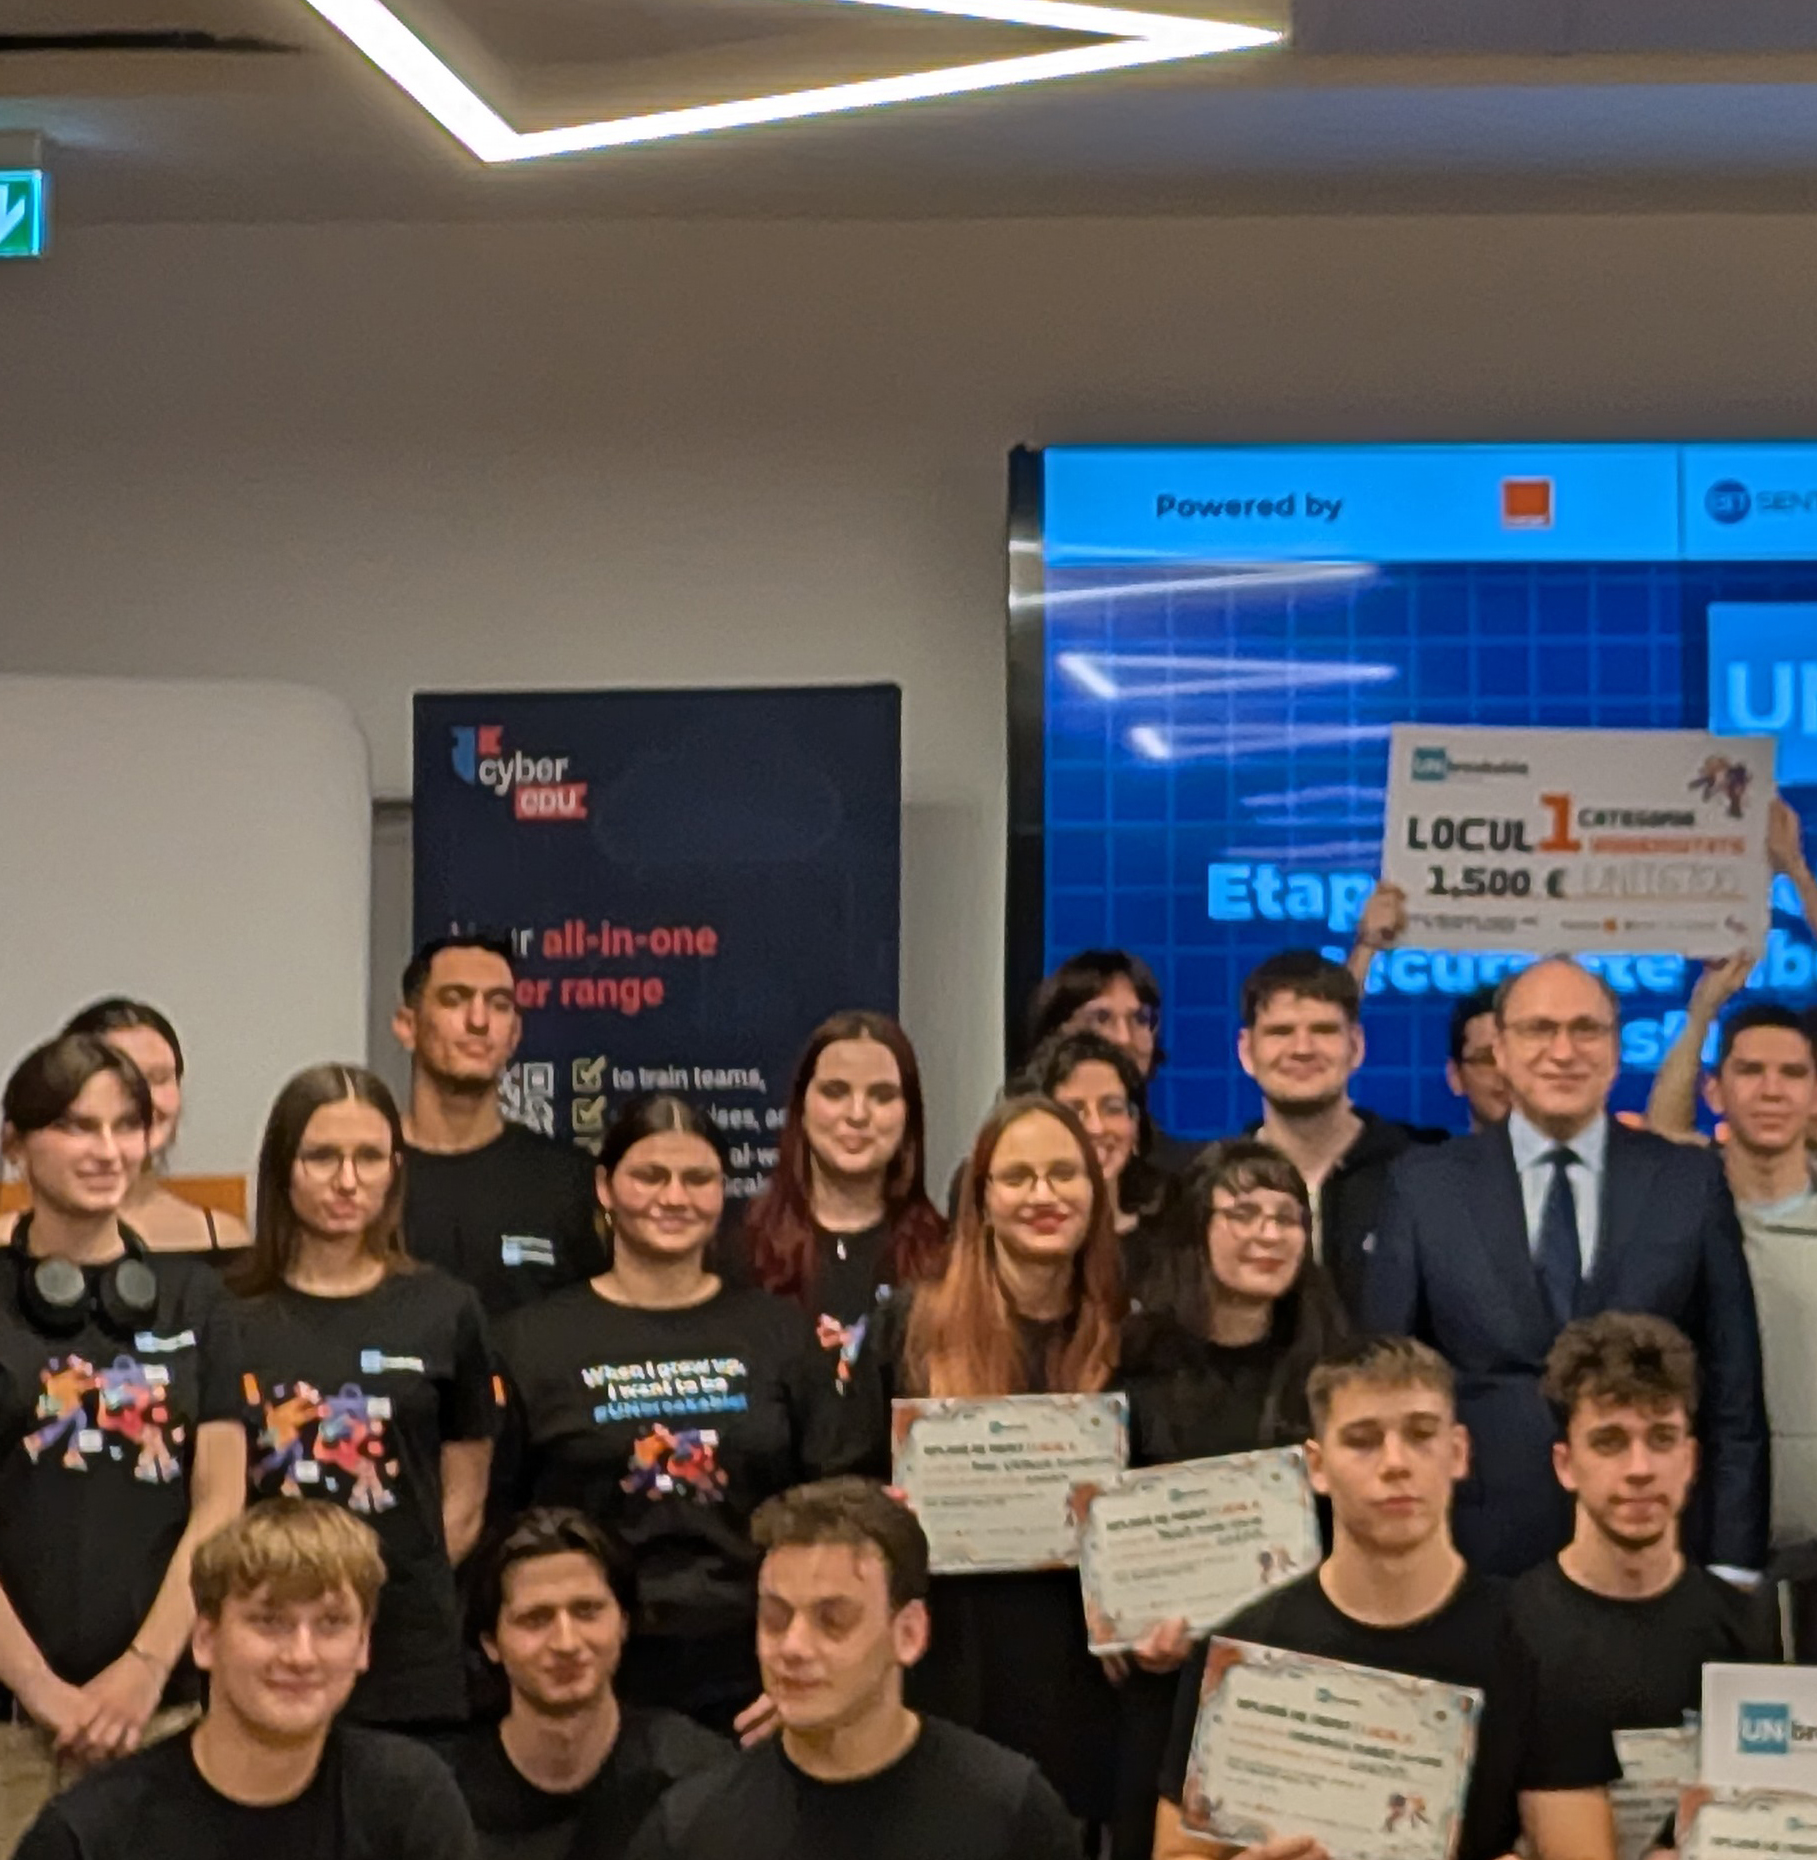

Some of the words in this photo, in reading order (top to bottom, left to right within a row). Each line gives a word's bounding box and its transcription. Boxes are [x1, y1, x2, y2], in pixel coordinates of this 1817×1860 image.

[1156, 494, 1295, 518] Powered
[1305, 493, 1343, 522] by
[478, 750, 569, 796] cyber
[1407, 816, 1534, 853] LOCUL
[1539, 792, 1581, 853] 1
[1207, 862, 1377, 928] Etap
[1426, 866, 1532, 899] 1,500
[542, 920, 718, 958] all-in-one
[560, 977, 664, 1015] range
[613, 1066, 635, 1090] to
